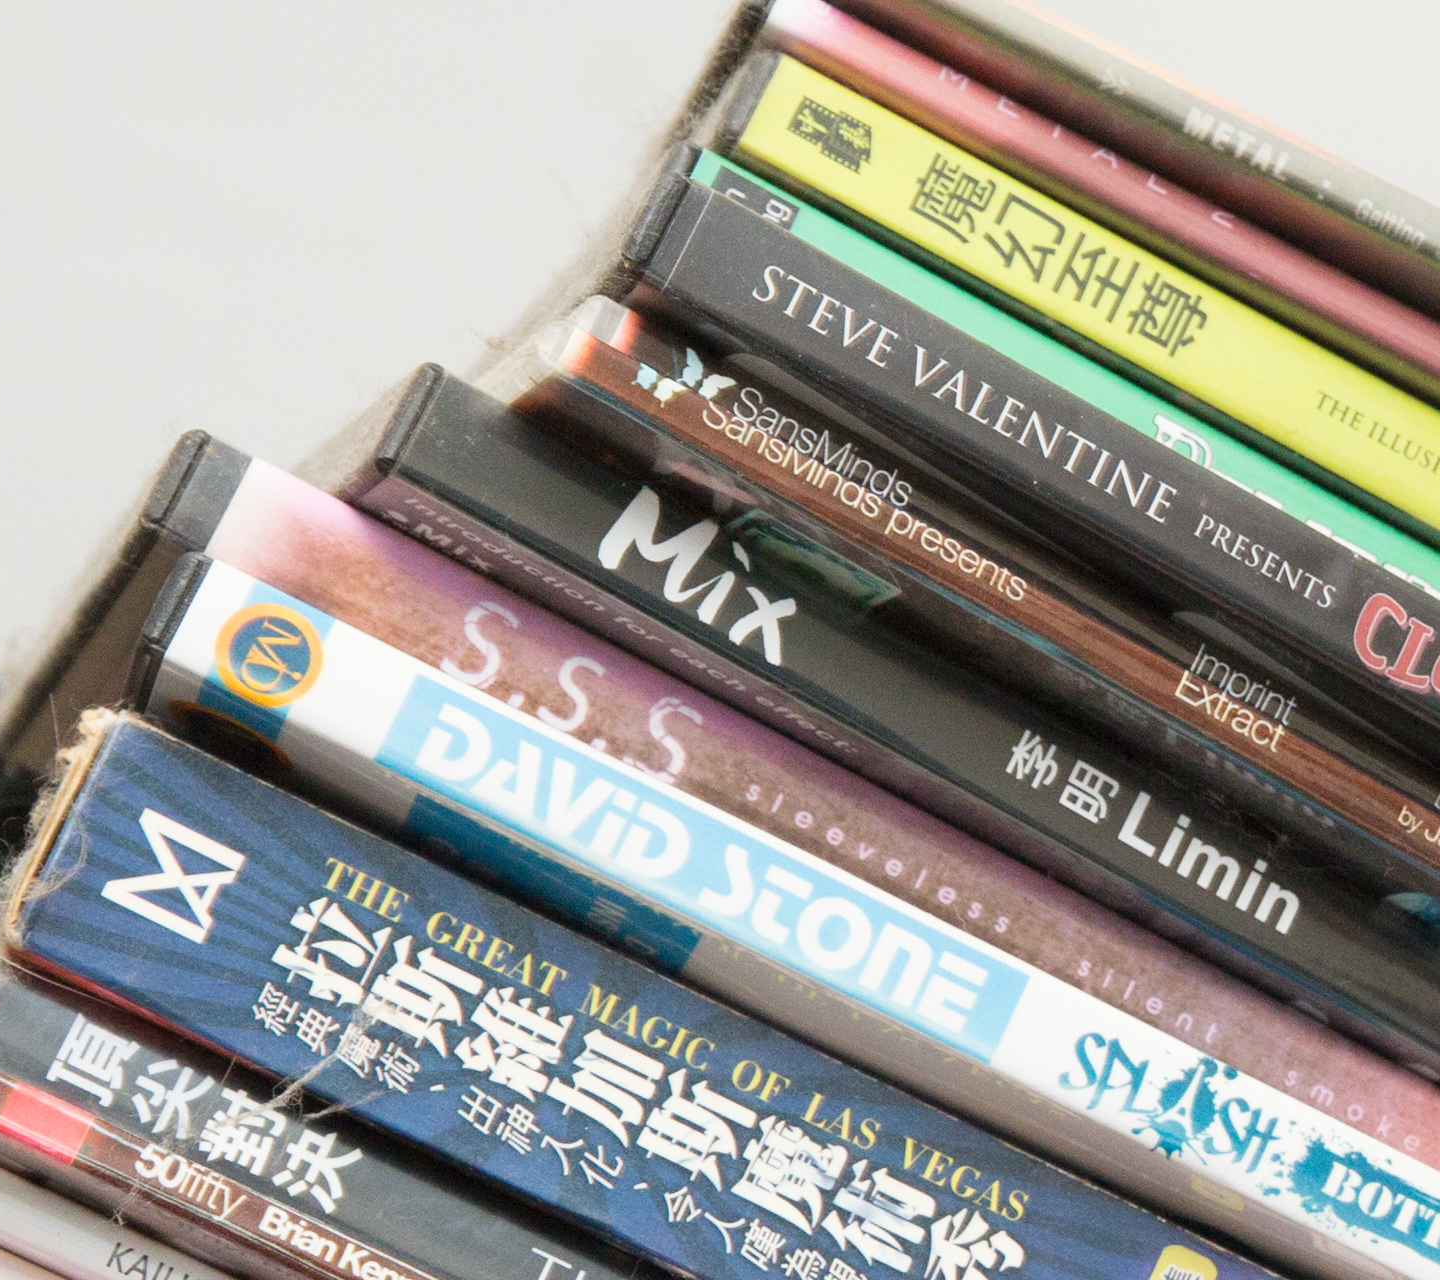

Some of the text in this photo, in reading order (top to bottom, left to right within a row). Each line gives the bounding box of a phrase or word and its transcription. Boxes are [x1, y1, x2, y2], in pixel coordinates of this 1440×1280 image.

[1179, 106, 1295, 182] METAL
[1350, 196, 1429, 252] Getting
[901, 149, 1217, 364] 魔幻至尊
[730, 385, 914, 510] SansMinds
[749, 261, 902, 370] STEVE
[897, 344, 1181, 526] VALENTINE
[1191, 513, 1340, 612] PRESENTS
[1309, 389, 1367, 433] THE
[403, 493, 607, 617] Introduction
[611, 612, 667, 652] for
[591, 484, 801, 667] Mix
[883, 507, 1031, 603] presents
[1173, 671, 1288, 755] Extract
[1186, 643, 1301, 728] Imprint
[1001, 727, 1123, 827] 李明
[1114, 790, 1314, 938] Limin
[1393, 803, 1426, 836] by
[314, 855, 412, 924] THE
[421, 908, 570, 1001] GREAT
[576, 982, 718, 1073] MAGIC
[726, 1056, 790, 1110] OF
[798, 1091, 885, 1153] LAS
[890, 1136, 1032, 1225] VEGAS
[742, 778, 1015, 938] sleeveless
[1073, 954, 1224, 1048] silent
[1281, 1065, 1425, 1155] smoke
[44, 1012, 369, 1217] 頂尖對決
[130, 1142, 249, 1227] 50fifty
[256, 1203, 346, 1265] Brian
